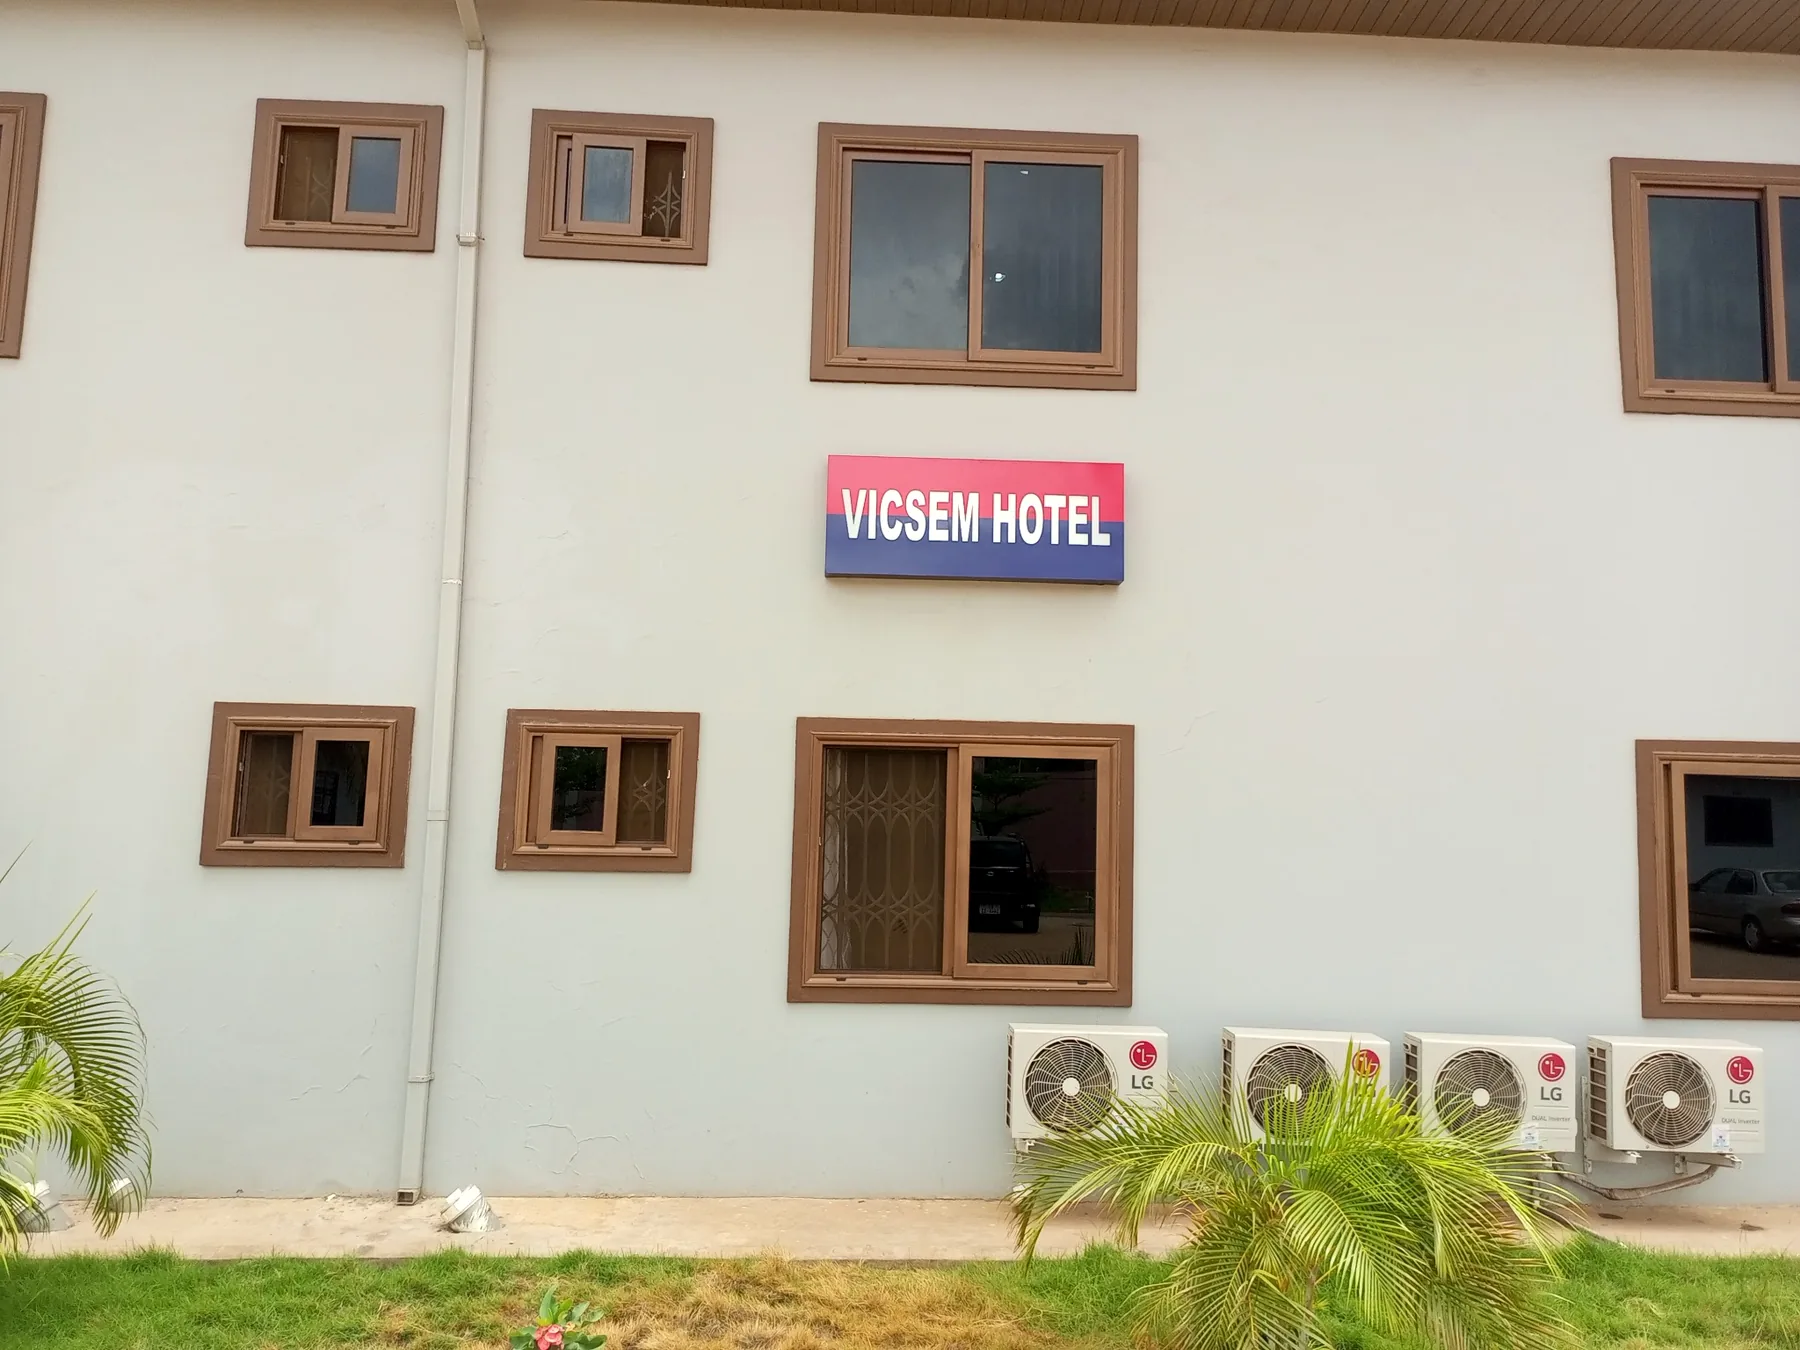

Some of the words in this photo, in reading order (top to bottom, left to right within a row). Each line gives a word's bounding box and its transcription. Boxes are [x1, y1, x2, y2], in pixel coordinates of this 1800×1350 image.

[841, 488, 980, 543] VICSEM
[992, 492, 1112, 546] HOTEL
[1131, 1075, 1154, 1090] LG
[1540, 1086, 1562, 1101] LG
[1729, 1089, 1751, 1104] LG
